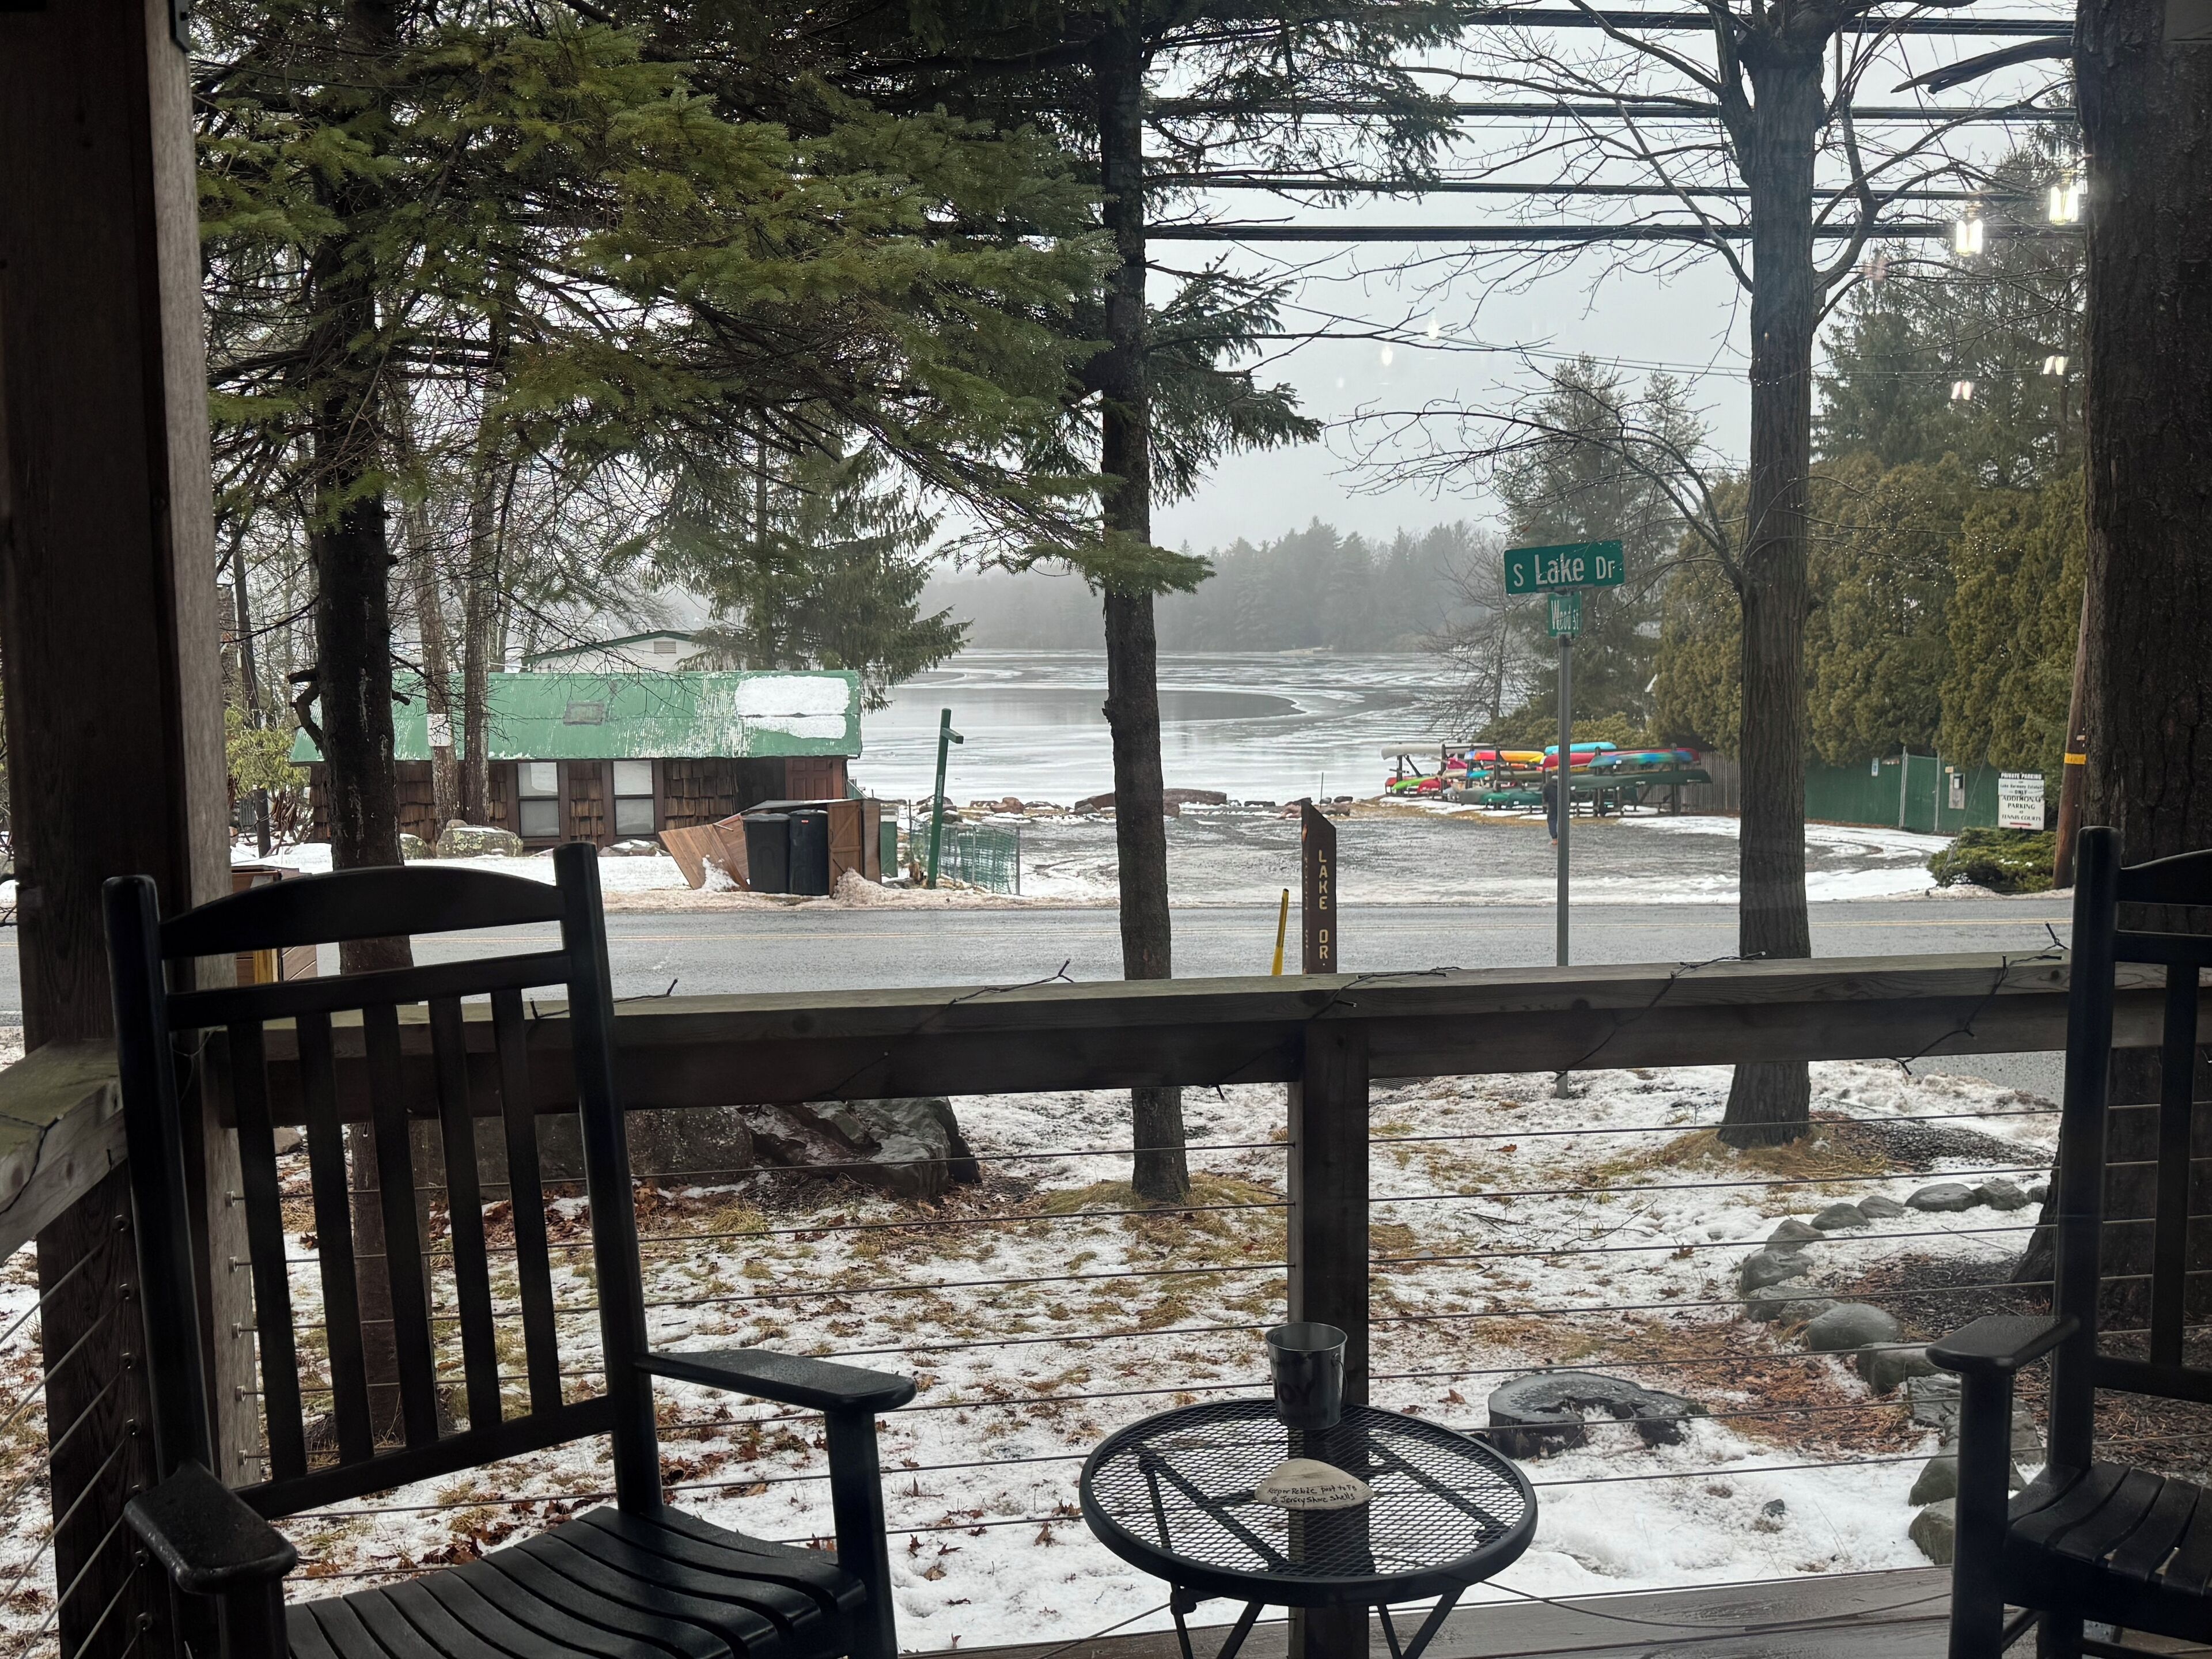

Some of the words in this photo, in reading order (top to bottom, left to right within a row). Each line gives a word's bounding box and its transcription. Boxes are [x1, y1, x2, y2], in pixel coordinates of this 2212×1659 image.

[1513, 563, 1524, 586] S
[1534, 552, 1585, 585] Lake
[1595, 555, 1615, 579] Dr
[1319, 849, 1328, 910] LAKE
